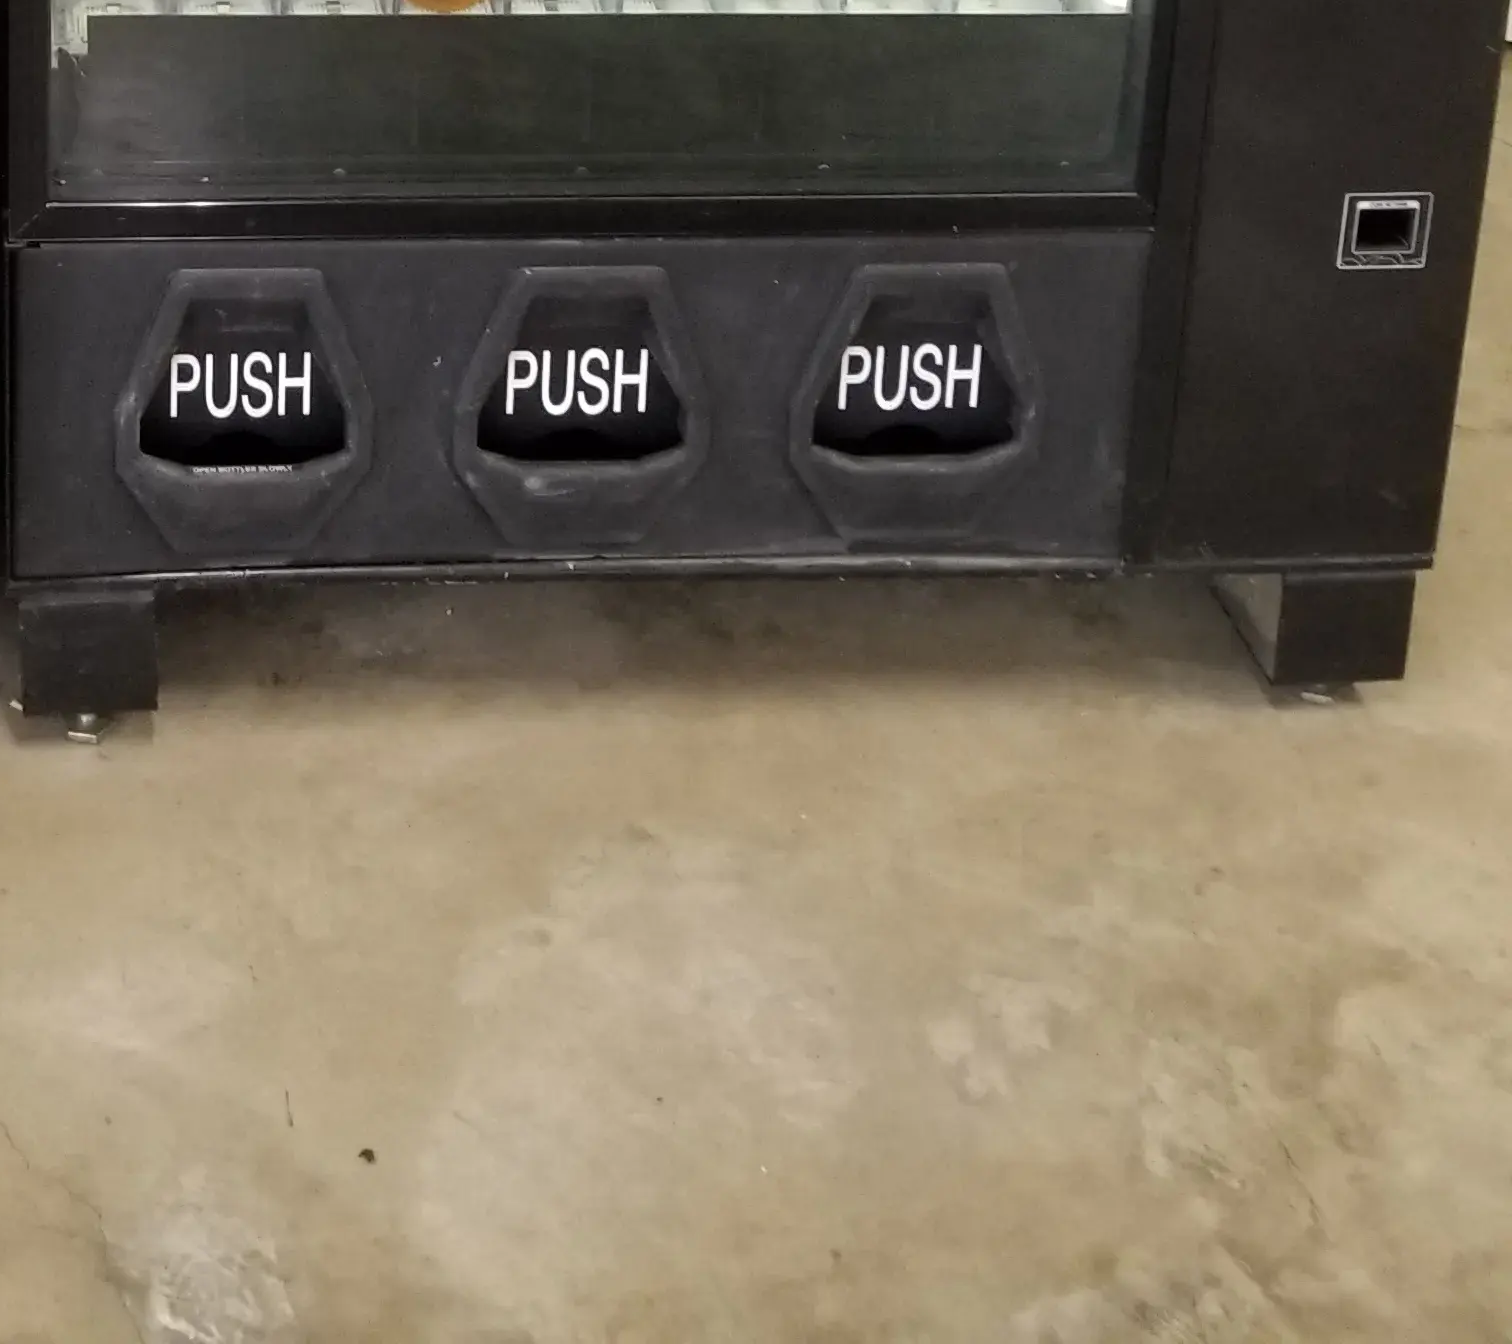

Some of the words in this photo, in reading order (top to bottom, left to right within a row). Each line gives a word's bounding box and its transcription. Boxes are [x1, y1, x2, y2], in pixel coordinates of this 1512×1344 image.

[168, 350, 312, 419] PUSH
[504, 347, 649, 416] PUSH
[838, 342, 984, 411] PUSH
